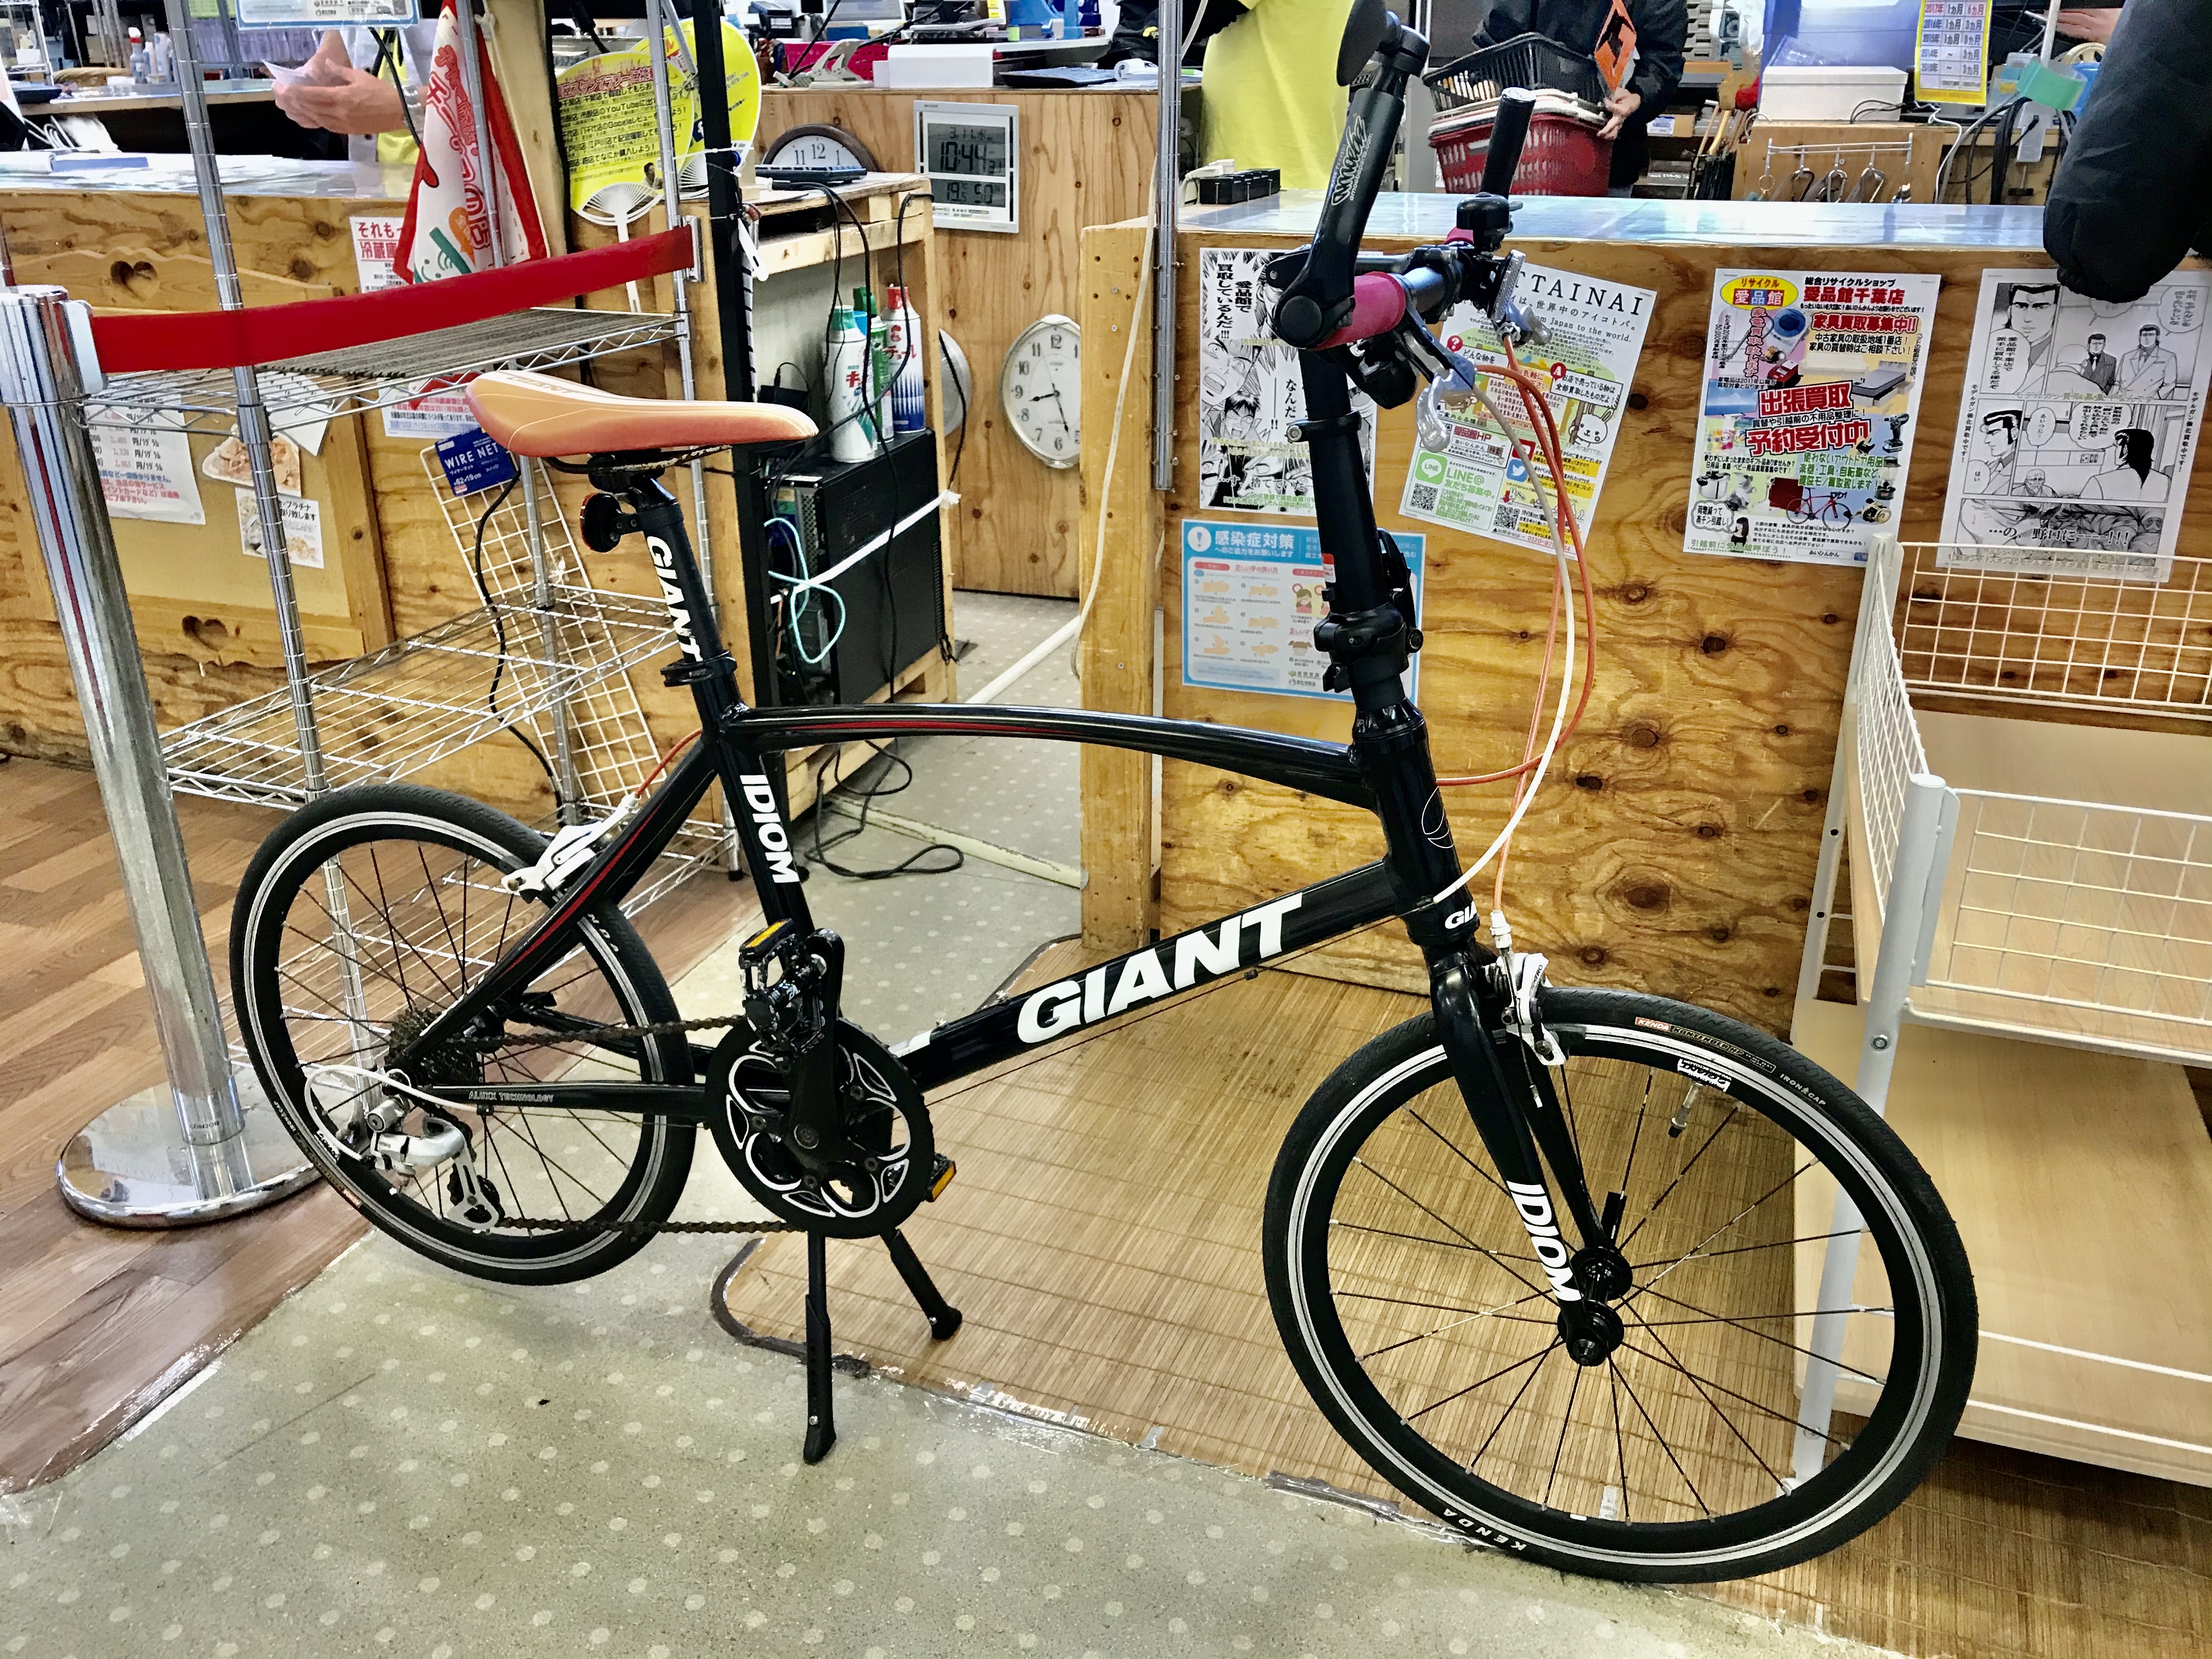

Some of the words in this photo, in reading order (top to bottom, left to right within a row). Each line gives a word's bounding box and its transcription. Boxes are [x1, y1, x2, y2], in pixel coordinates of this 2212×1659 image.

[794, 150, 806, 165] 11
[811, 143, 825, 159] 12
[836, 150, 840, 165] 1
[1741, 278, 1780, 288] リサイクル
[1805, 276, 1896, 287] 総合リサイクルショップ
[1235, 281, 1252, 313] 愛品館で
[1735, 290, 1784, 306] 愛品館
[1803, 286, 1905, 305] 愛品館千葉店
[1550, 318, 1574, 331] Japan
[1577, 324, 1585, 332] to
[1589, 325, 1602, 336] the
[1606, 331, 1632, 342] world.
[1051, 335, 1062, 349] 12
[1815, 333, 1909, 345] 中古家具の取扱地域1番店！
[1032, 343, 1041, 357] 11
[1074, 344, 1078, 358] 1
[1463, 349, 1495, 364] どんな物を
[1809, 343, 1911, 355] 家具の買替時はご相談下さい！
[2003, 336, 2018, 372] 愛品館千葉店で
[1018, 361, 1030, 375] 10
[1562, 374, 1616, 393] お店で売っている物は
[1015, 385, 1024, 399] 9
[1556, 383, 1615, 404] 全部買取したものだよ！
[1760, 385, 1852, 416] 出張買取
[1020, 408, 1029, 421] 8
[1752, 409, 1867, 428] 買替や引越前の不用品整理に！
[1035, 428, 1042, 441] 7
[1453, 425, 1492, 442] 愛品館HP
[1746, 419, 1870, 456] 予約受付中
[1054, 437, 1063, 450] 6
[1454, 439, 1485, 451] あいひんかん
[444, 451, 475, 469] WIRE
[477, 442, 499, 459] NET
[1424, 463, 1439, 472] LINE
[1446, 467, 1485, 485] LINE@
[1444, 479, 1494, 499] 友だち募集中。
[1215, 531, 1295, 550] 感染症対策
[647, 535, 703, 663] GIANT
[740, 774, 800, 884] IDIOM
[1017, 891, 1303, 1044] GIANT
[1638, 1019, 1669, 1031] KENDA
[469, 1091, 497, 1101] ALUXX
[499, 1092, 554, 1103] TECHNOLOGY
[1780, 1073, 1803, 1090] IRON
[1808, 1092, 1826, 1106] CAP
[1506, 1181, 1584, 1302] IDIOM
[1442, 1506, 1526, 1553] KENDA
